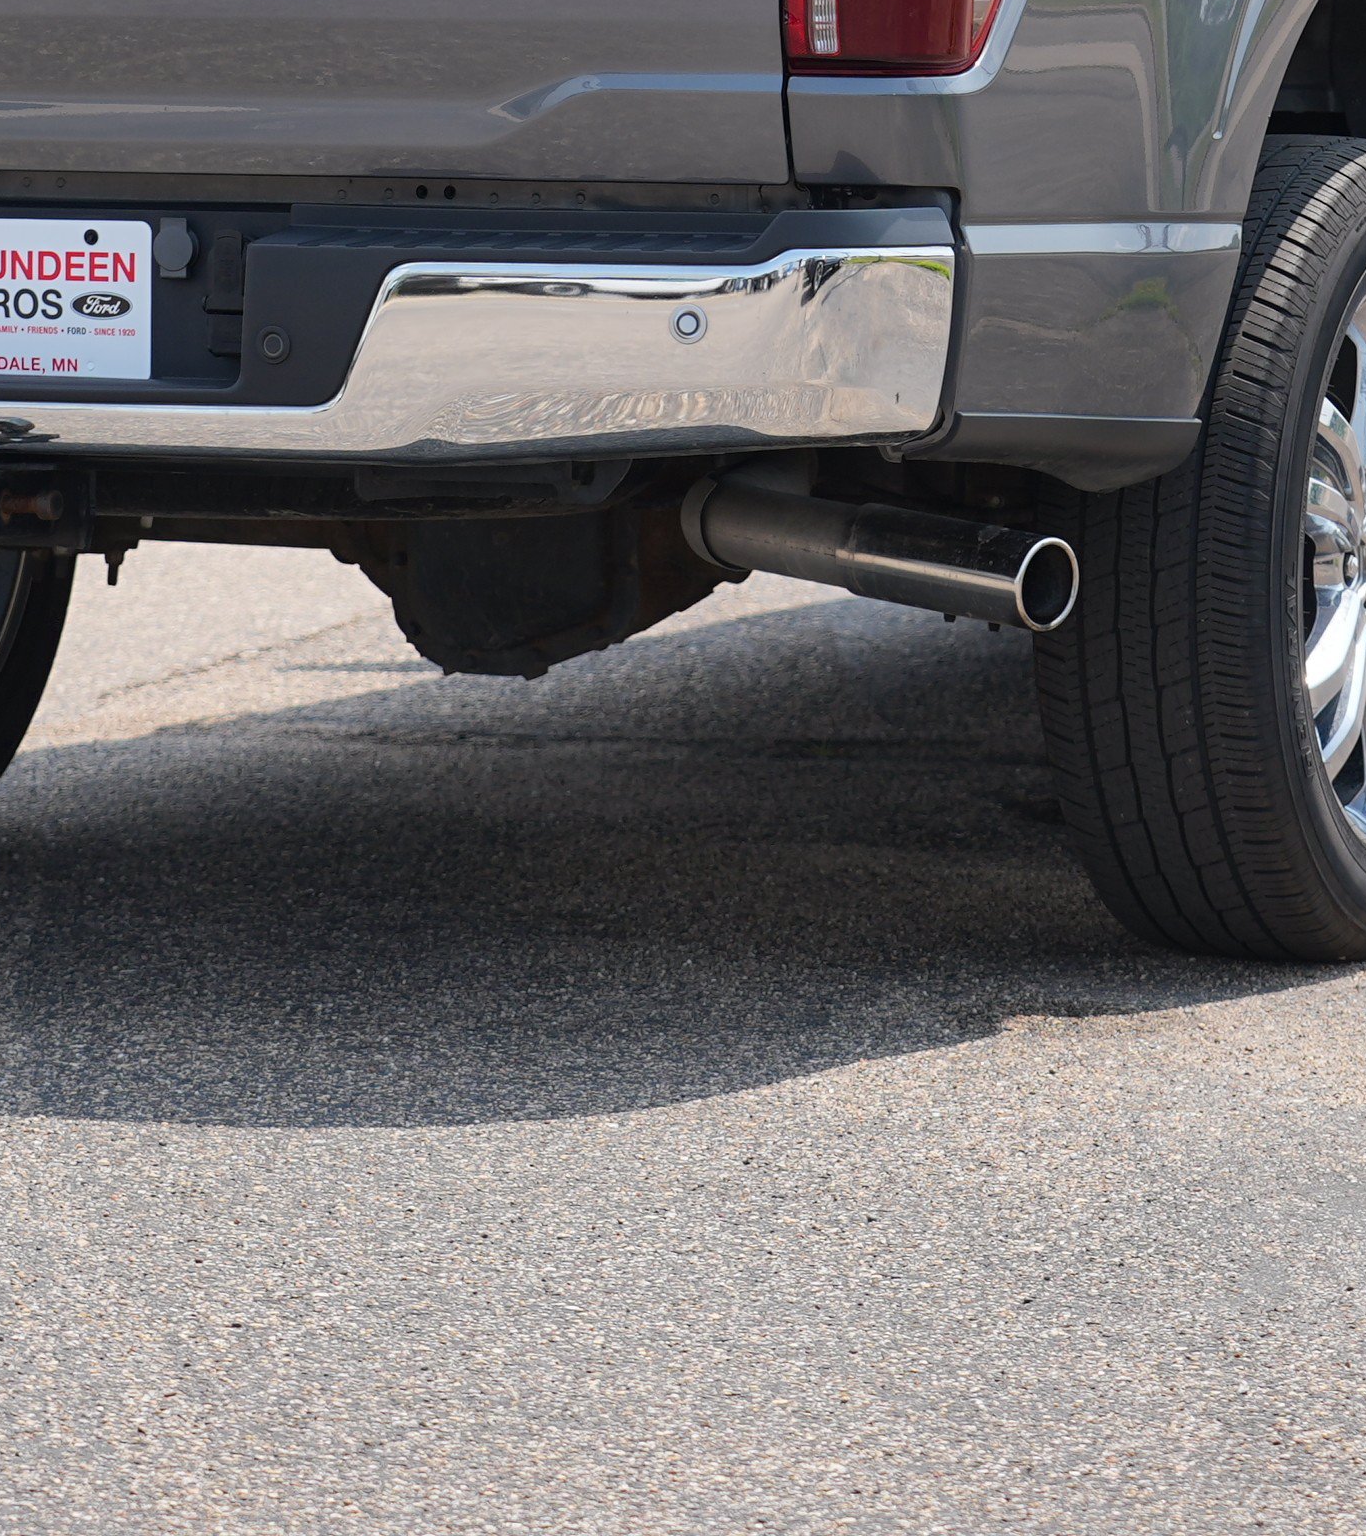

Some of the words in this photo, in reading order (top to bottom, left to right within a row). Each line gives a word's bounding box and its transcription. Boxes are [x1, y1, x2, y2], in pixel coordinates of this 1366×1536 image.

[82, 296, 121, 315] Ford
[27, 326, 58, 335] FRIENDS
[67, 327, 86, 335] FORD
[94, 328, 116, 336] SINCE
[118, 329, 135, 337] 1920
[52, 358, 78, 372] MN
